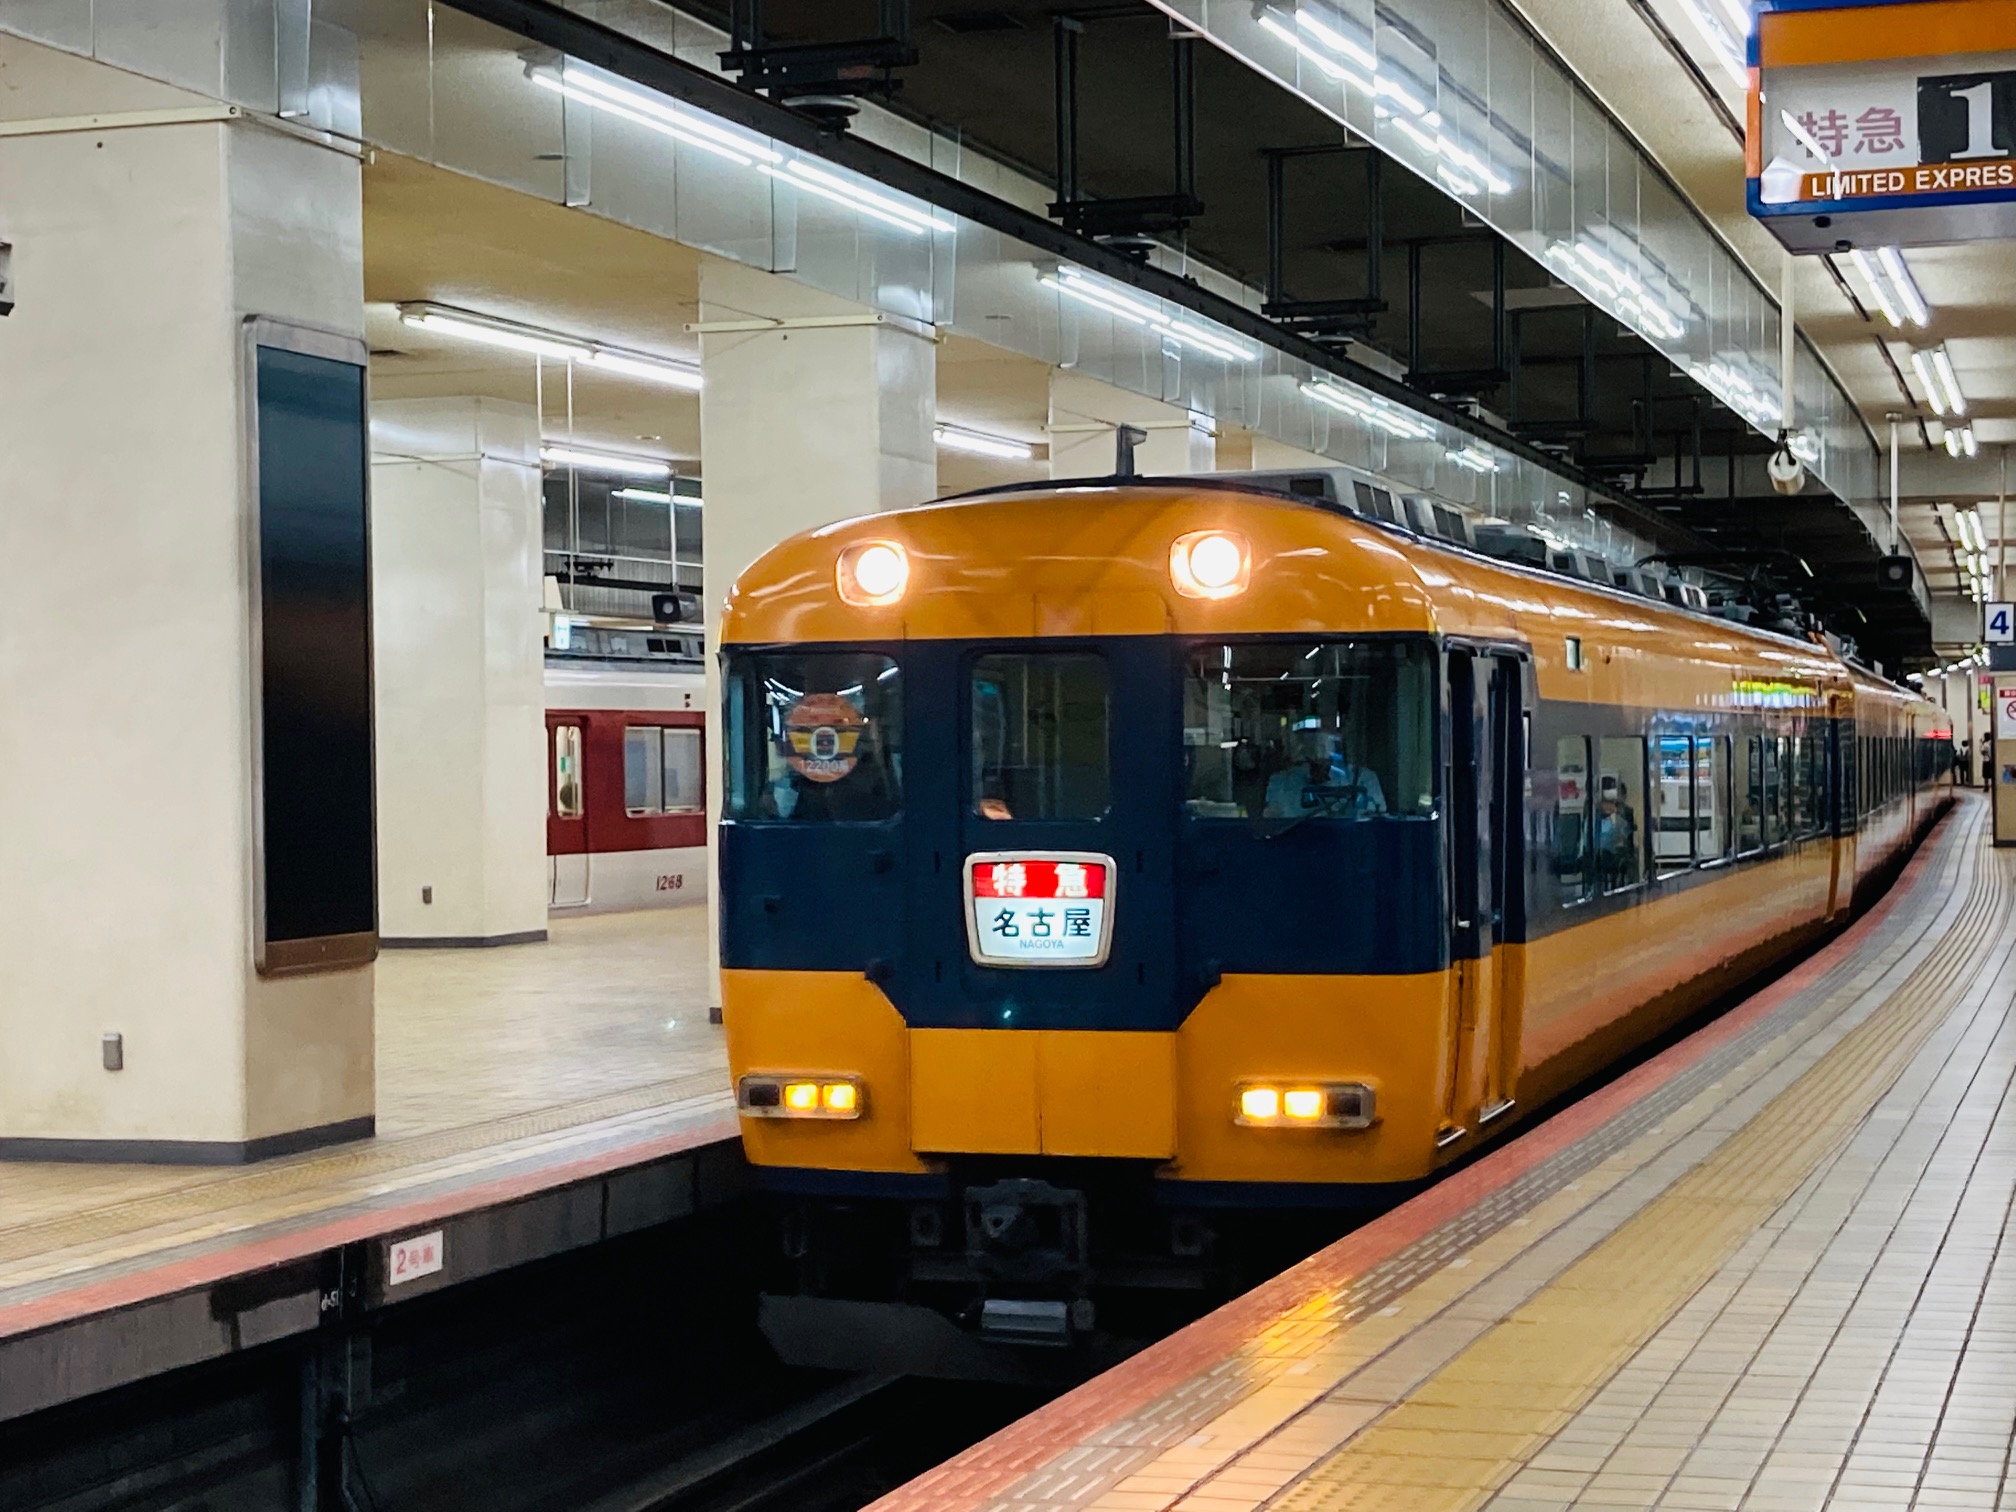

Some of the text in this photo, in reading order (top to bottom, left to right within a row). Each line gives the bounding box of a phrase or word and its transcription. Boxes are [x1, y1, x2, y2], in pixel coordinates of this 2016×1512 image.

[1796, 107, 1905, 158] 特急
[1950, 82, 2009, 159] 1
[1811, 172, 1905, 197] LIMITED
[1990, 610, 2010, 635] 4
[799, 759, 850, 773] 12200
[992, 863, 1088, 896] 特急
[992, 907, 1091, 937] 名古屋
[1019, 939, 1064, 949] NAGOYA
